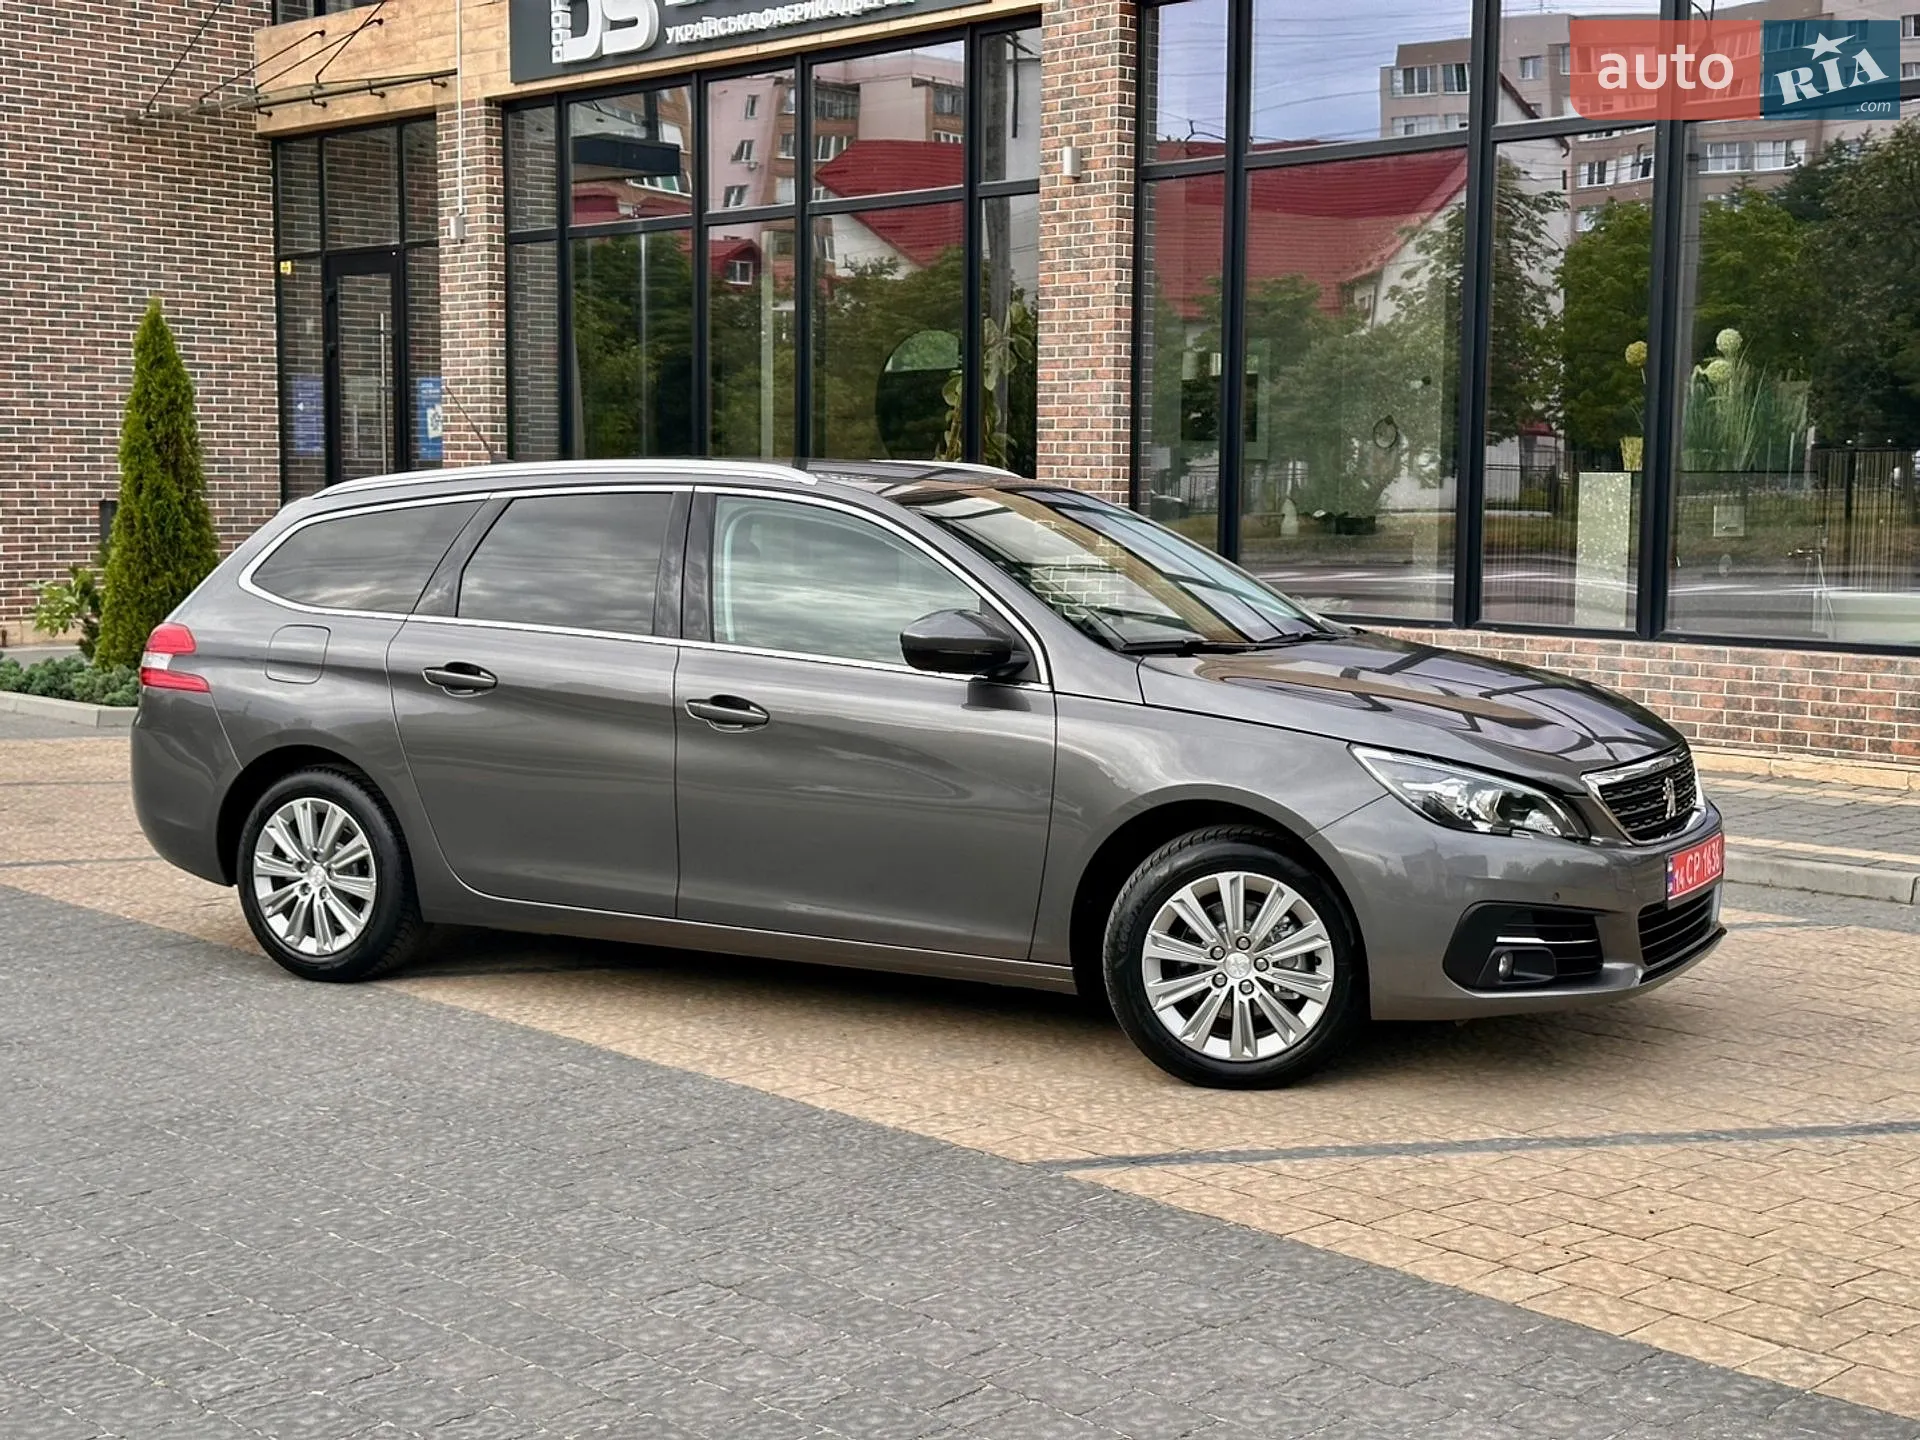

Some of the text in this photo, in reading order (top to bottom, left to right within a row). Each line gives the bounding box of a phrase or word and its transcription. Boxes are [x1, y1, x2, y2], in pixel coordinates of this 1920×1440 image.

[665, 14, 763, 44] УКРАЇНСЬКА
[761, 0, 840, 28] ФАБРИКА
[1686, 851, 1700, 885] CP
